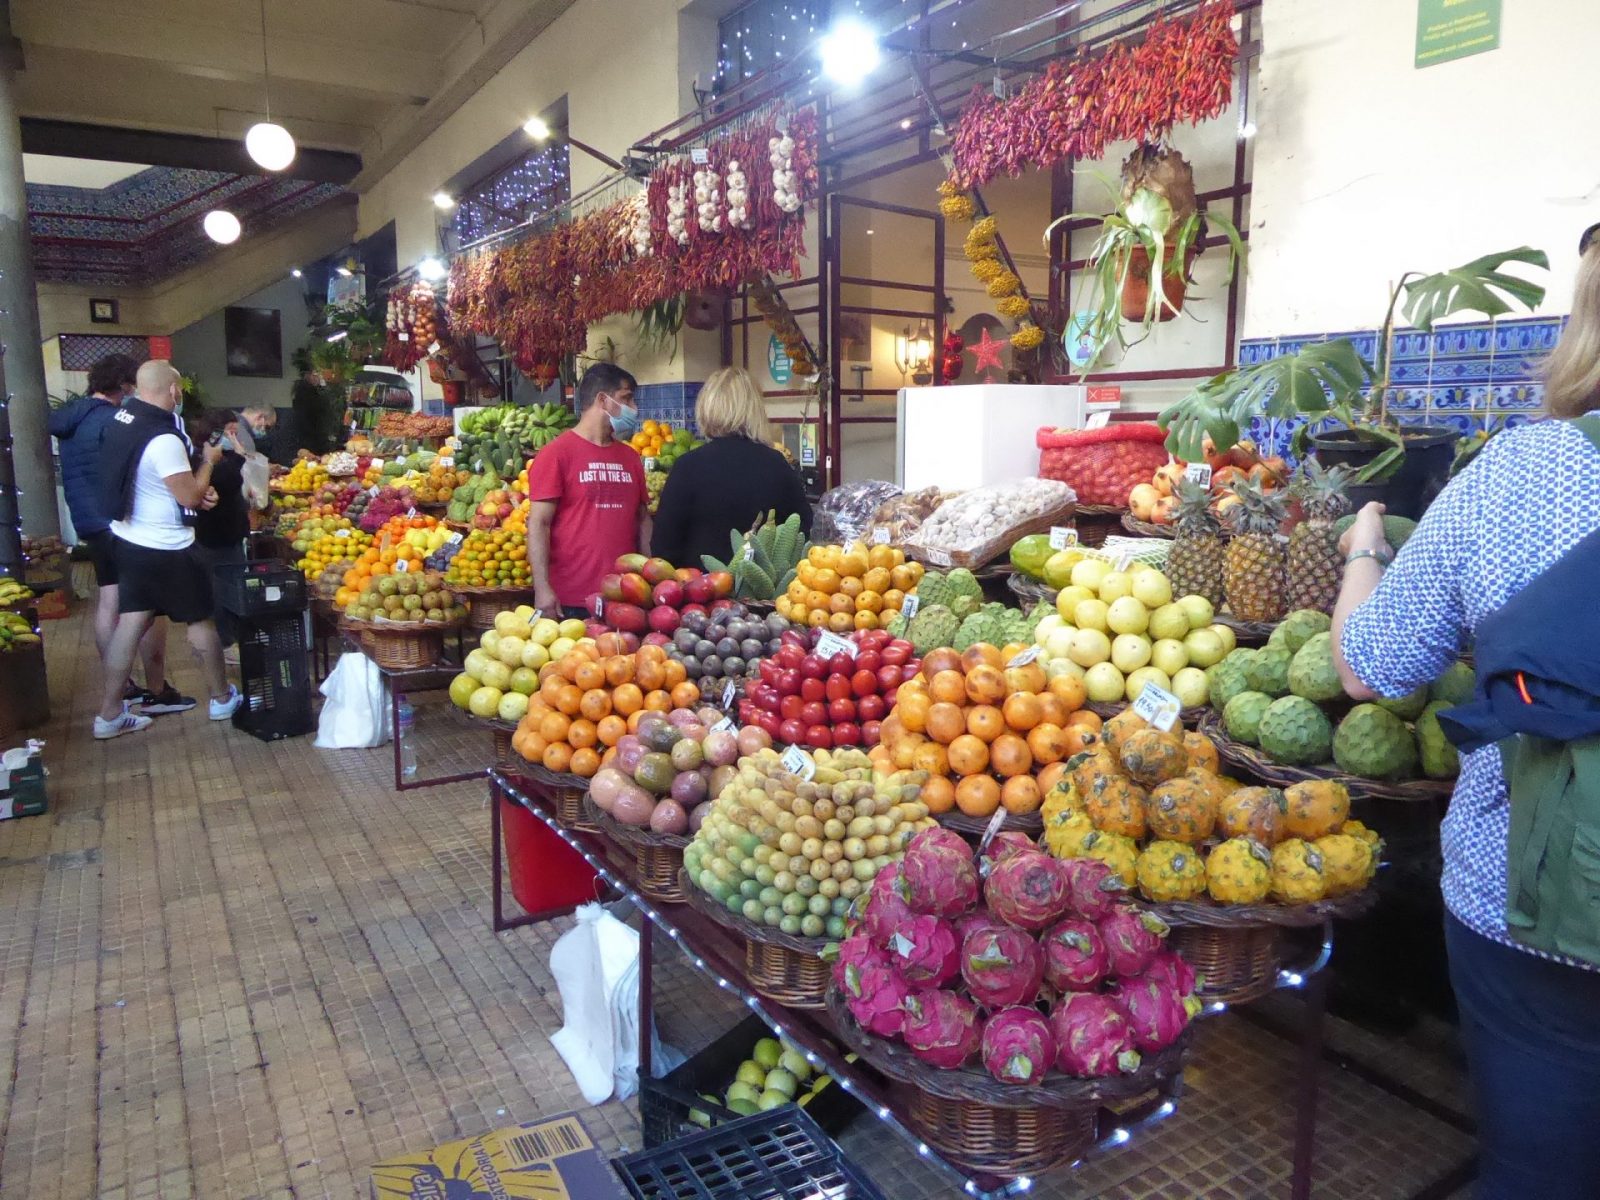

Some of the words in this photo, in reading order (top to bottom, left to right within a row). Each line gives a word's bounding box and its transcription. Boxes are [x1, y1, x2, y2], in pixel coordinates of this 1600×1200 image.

[580, 471, 596, 483] LOST
[599, 471, 606, 482] IN
[608, 471, 620, 482] THE
[621, 471, 632, 483] SEA
